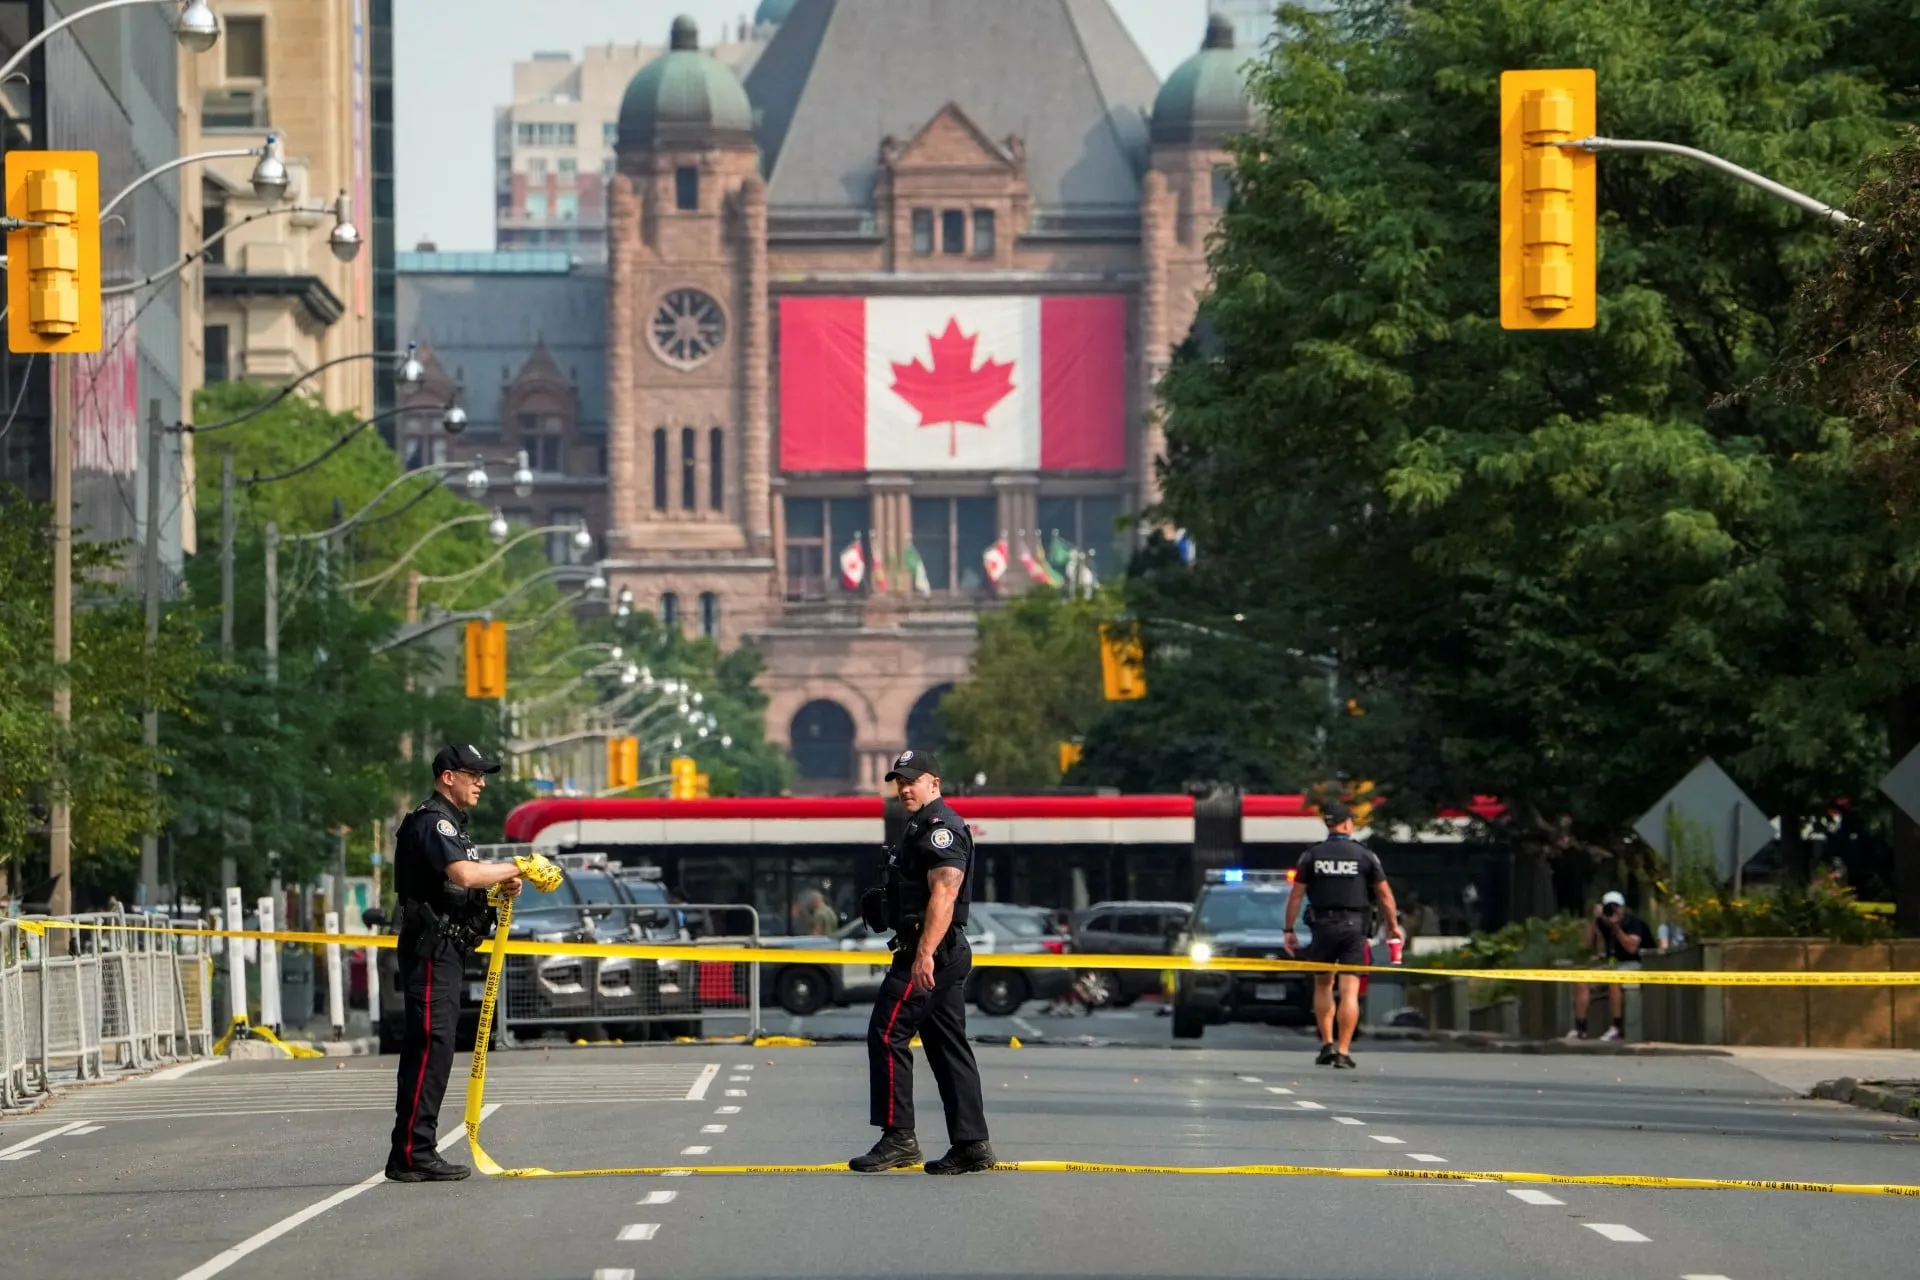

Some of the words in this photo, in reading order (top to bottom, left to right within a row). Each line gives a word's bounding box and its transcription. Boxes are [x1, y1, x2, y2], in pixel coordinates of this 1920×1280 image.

[1314, 860, 1359, 874] POLICE
[485, 971, 497, 997] CROSS
[482, 1000, 491, 1015] NOT
[480, 1017, 488, 1028] DO
[476, 1030, 486, 1049] LINE
[471, 1051, 482, 1079] POLICE
[1780, 1182, 1799, 1191] LINE
[1802, 1184, 1833, 1193] POLICE
